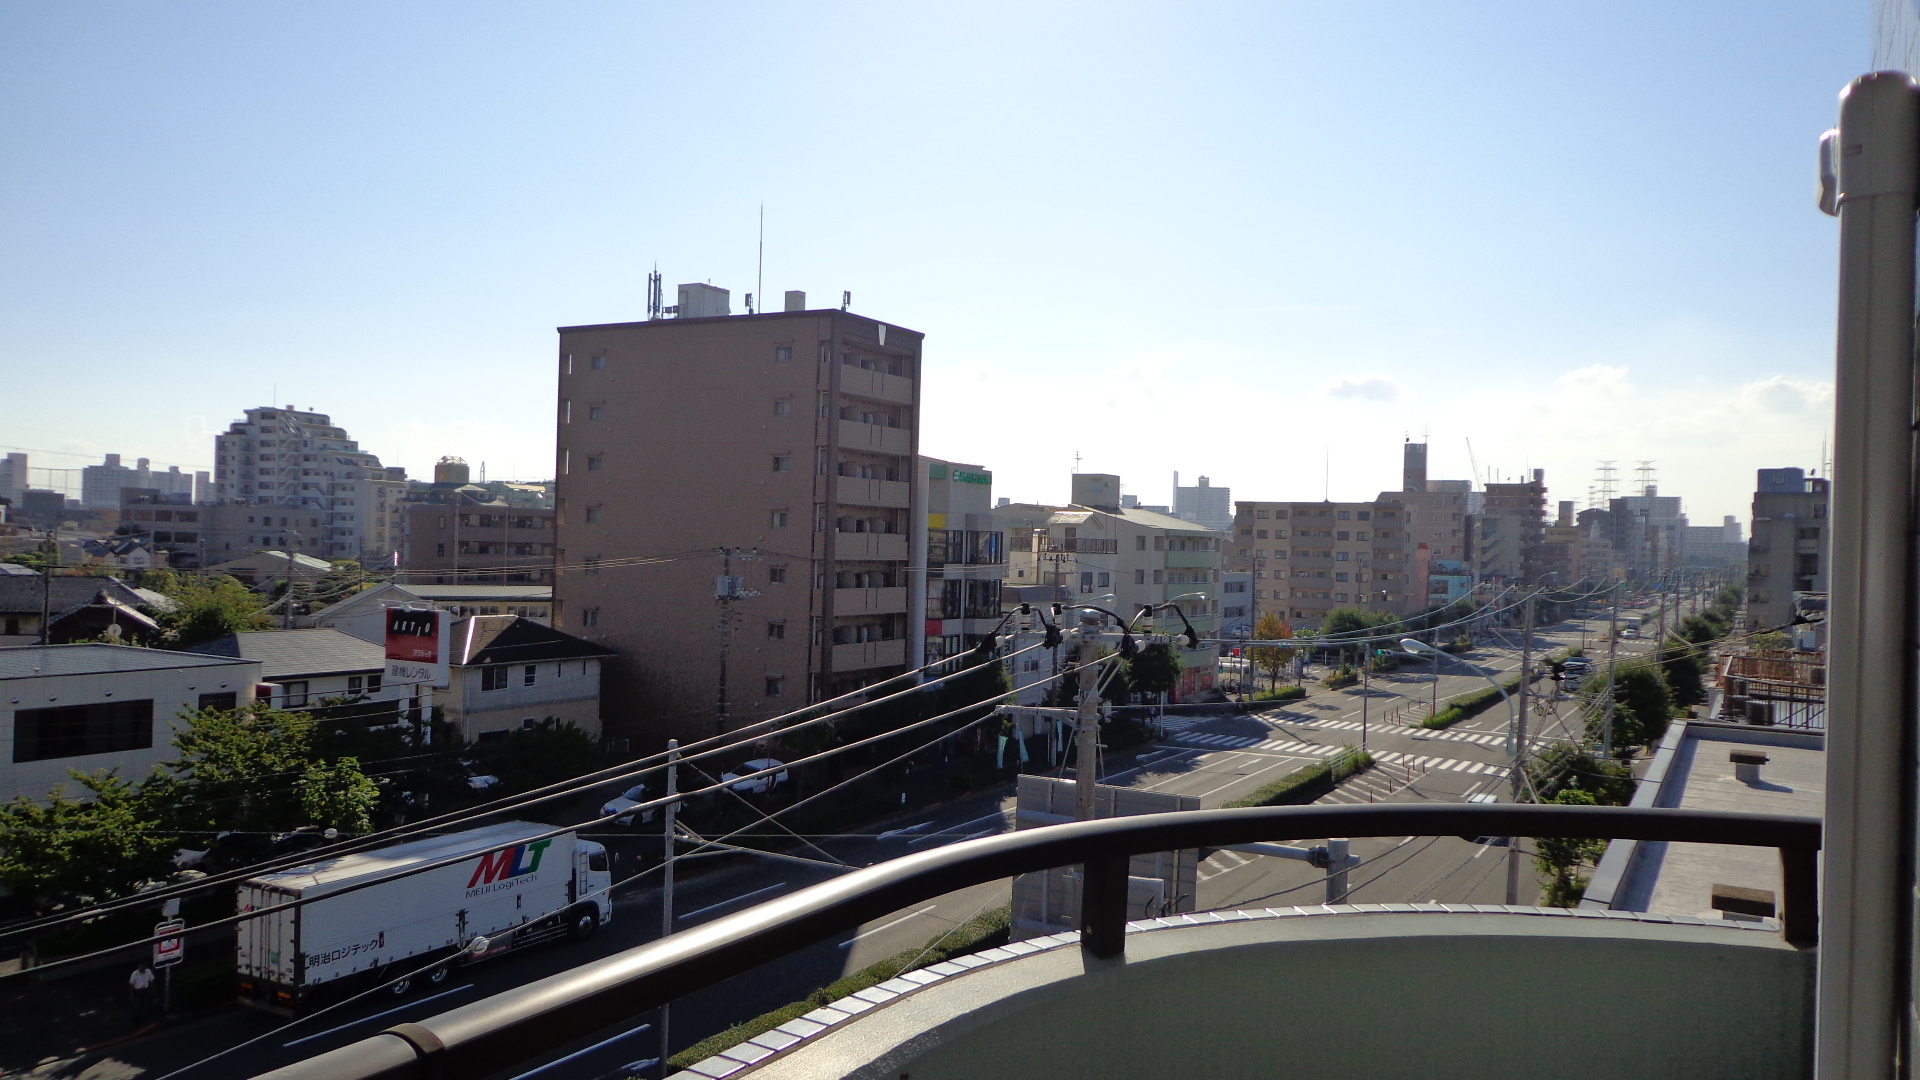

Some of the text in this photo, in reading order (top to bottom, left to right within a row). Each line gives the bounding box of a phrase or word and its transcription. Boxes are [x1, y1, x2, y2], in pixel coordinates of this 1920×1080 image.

[466, 838, 553, 889] MLT
[465, 885, 491, 899] MEIJI
[309, 938, 378, 967] 明治ロジテック
